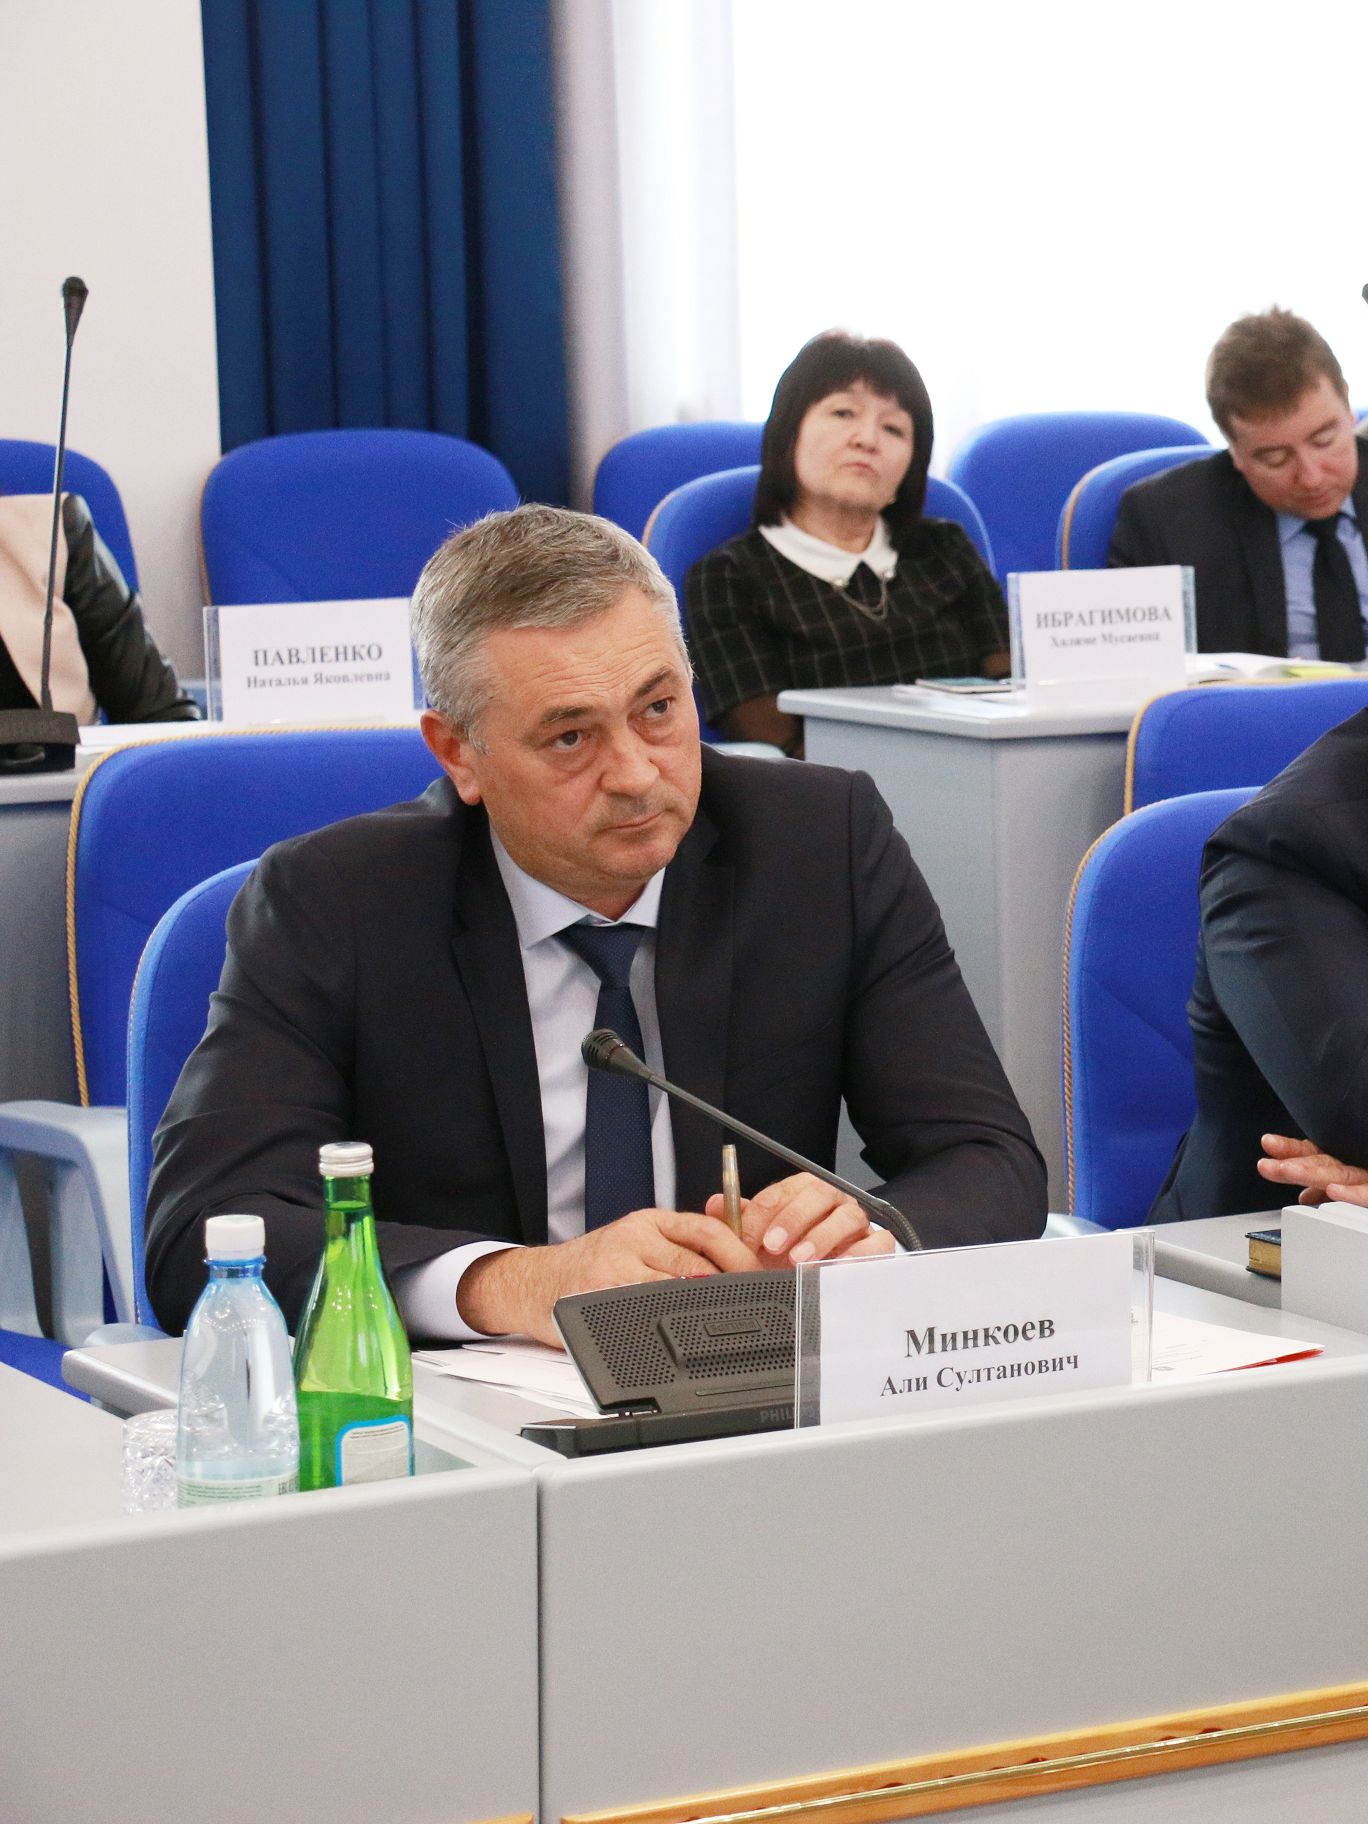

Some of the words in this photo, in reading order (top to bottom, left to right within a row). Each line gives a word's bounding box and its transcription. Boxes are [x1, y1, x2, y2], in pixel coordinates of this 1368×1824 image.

[1035, 605, 1173, 630] ИБРАГИМОВА
[1100, 631, 1161, 647] Мусаевна
[253, 644, 383, 667] ПАВЛЕНКО
[246, 675, 309, 689] Наталья
[312, 671, 392, 686] Яковлевна
[904, 1319, 1056, 1358] Минкоев
[880, 1375, 928, 1397] Али
[936, 1354, 1079, 1392] Султанович
